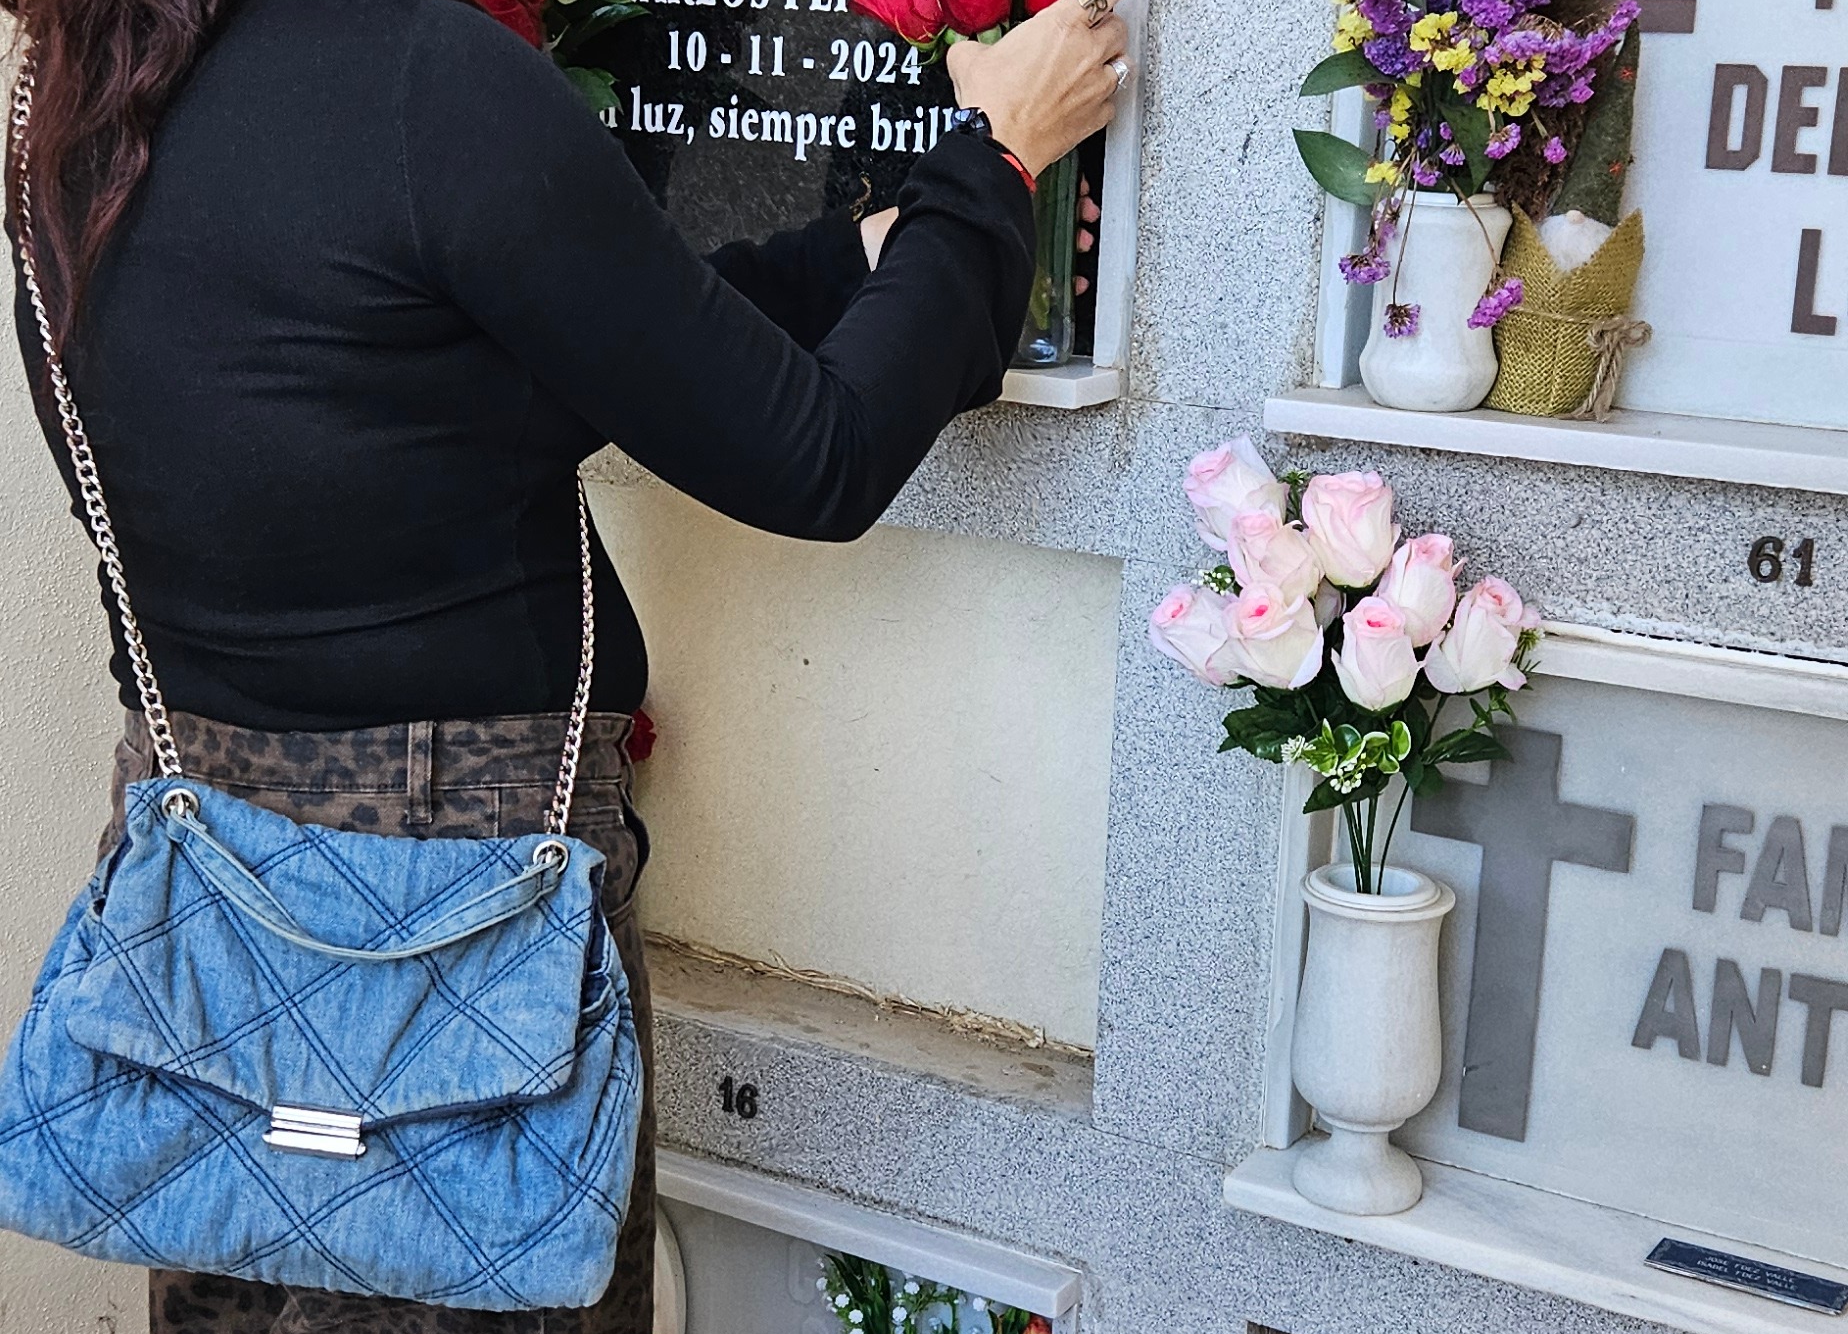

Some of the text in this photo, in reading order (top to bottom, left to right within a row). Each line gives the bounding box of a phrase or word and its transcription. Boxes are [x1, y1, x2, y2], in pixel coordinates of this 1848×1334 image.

[667, 30, 707, 72] 10
[748, 34, 786, 77] 11
[828, 39, 922, 85] 2024
[630, 85, 695, 145] luz,
[708, 94, 857, 162] siempre
[1746, 535, 1815, 587] 61
[719, 1075, 758, 1118] 16
